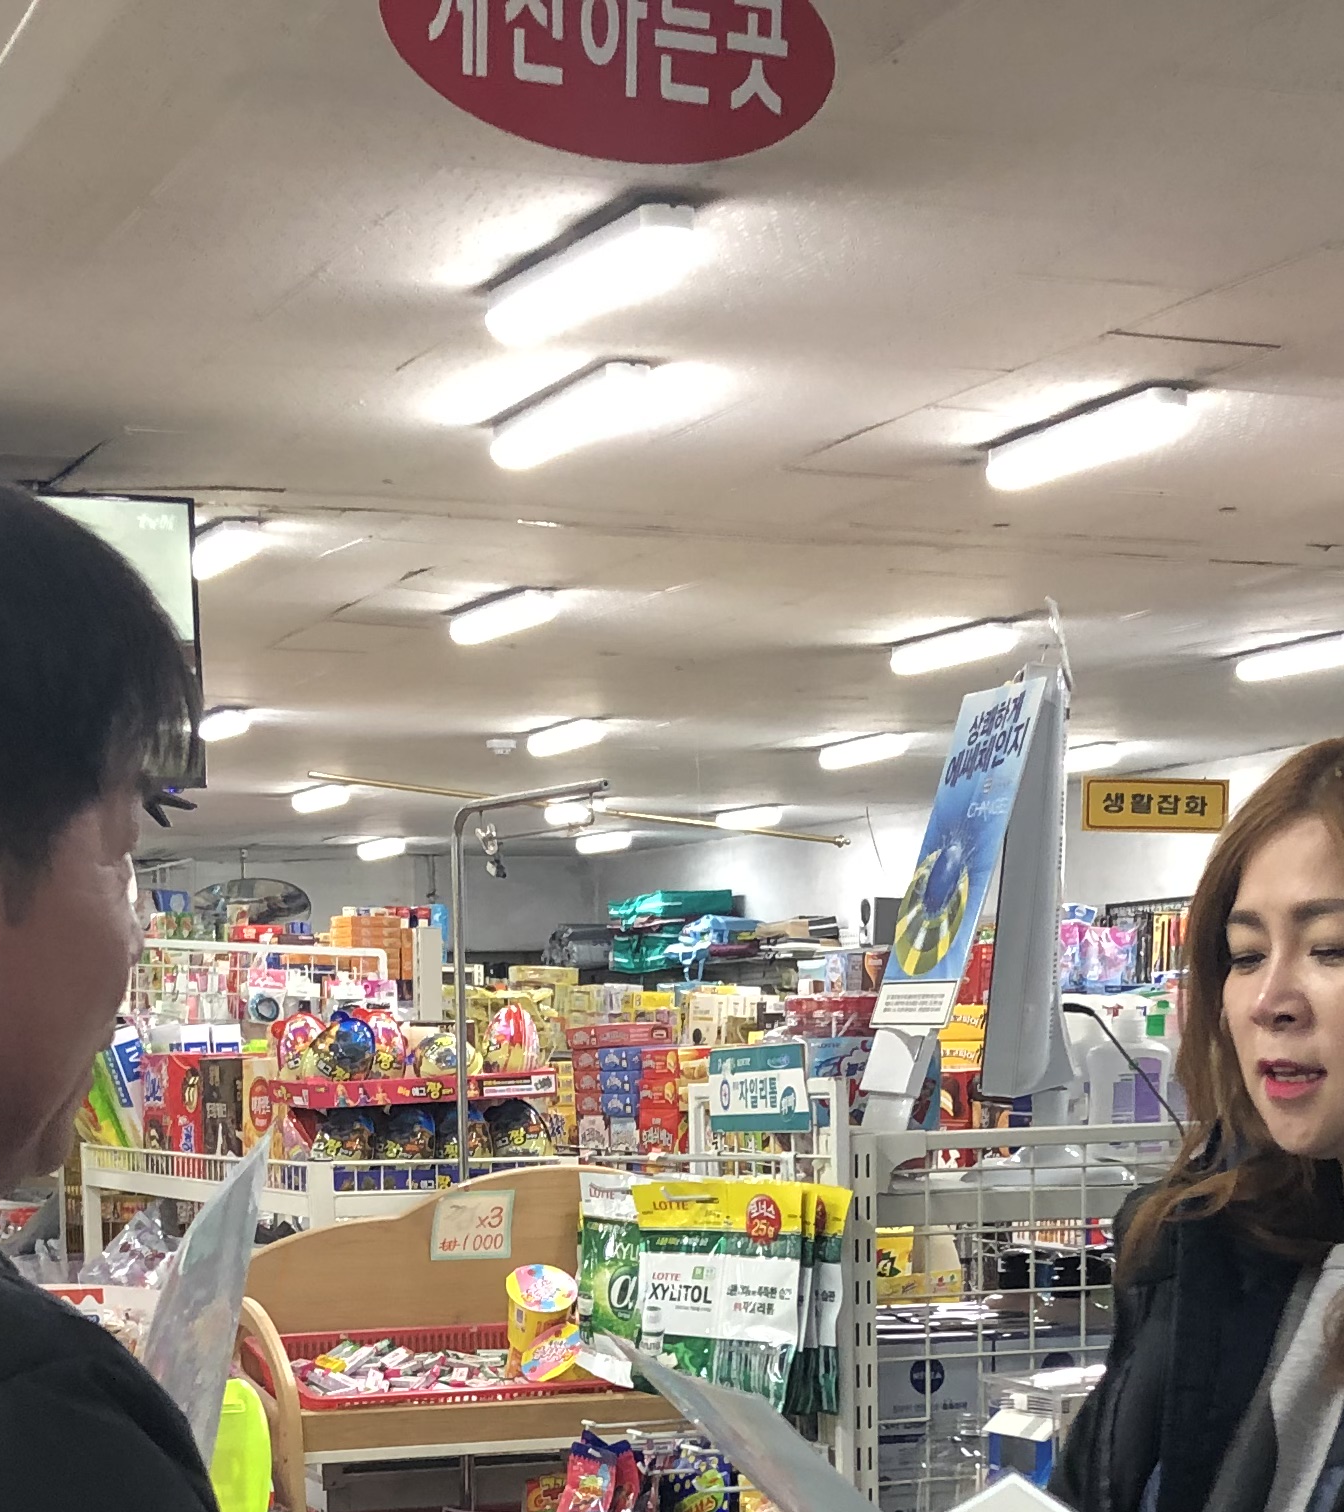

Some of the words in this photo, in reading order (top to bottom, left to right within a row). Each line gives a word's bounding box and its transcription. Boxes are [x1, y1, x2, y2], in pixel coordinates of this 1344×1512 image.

[967, 690, 1026, 746] 상쾌하게
[1102, 792, 1208, 817] 생활잡화
[738, 1077, 778, 1109] 자일리톨
[652, 1201, 689, 1211] LOTTE
[751, 1220, 775, 1238] 25g
[652, 1272, 682, 1281] LOTTE
